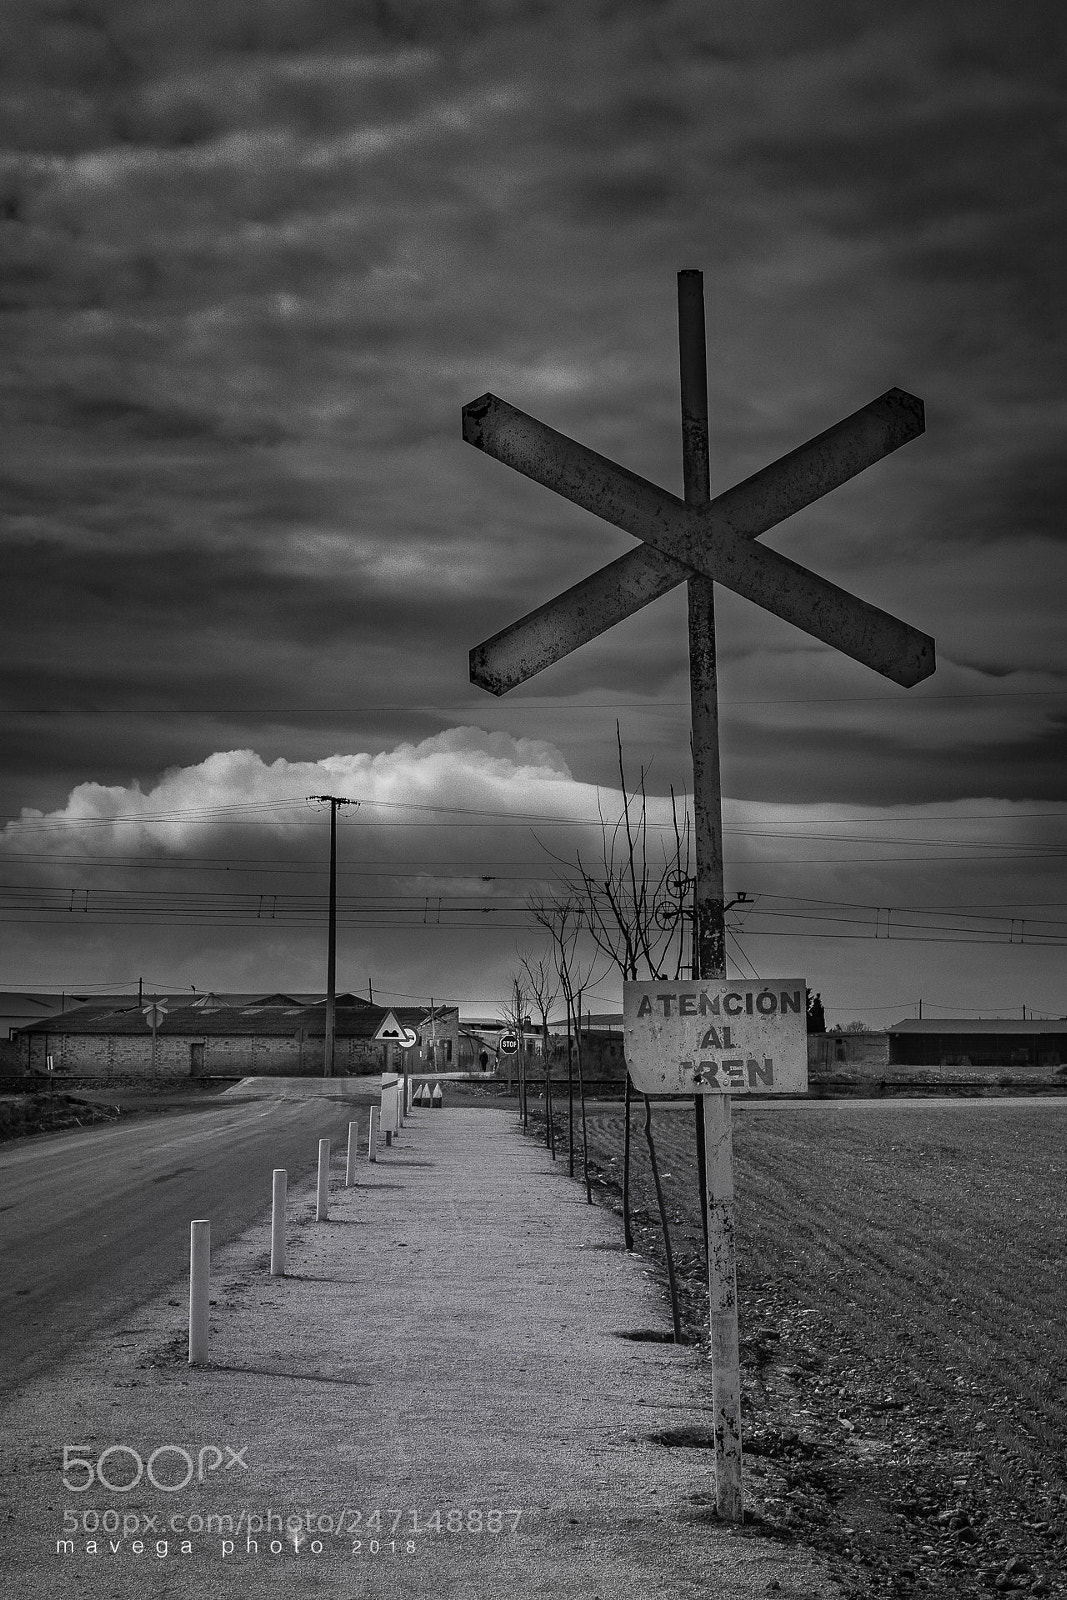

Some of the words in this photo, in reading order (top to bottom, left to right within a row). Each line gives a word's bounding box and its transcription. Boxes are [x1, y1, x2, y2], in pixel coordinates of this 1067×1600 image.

[637, 988, 801, 1018] ATENCIÓN
[502, 1040, 517, 1048] STOP
[700, 1026, 736, 1049] AL
